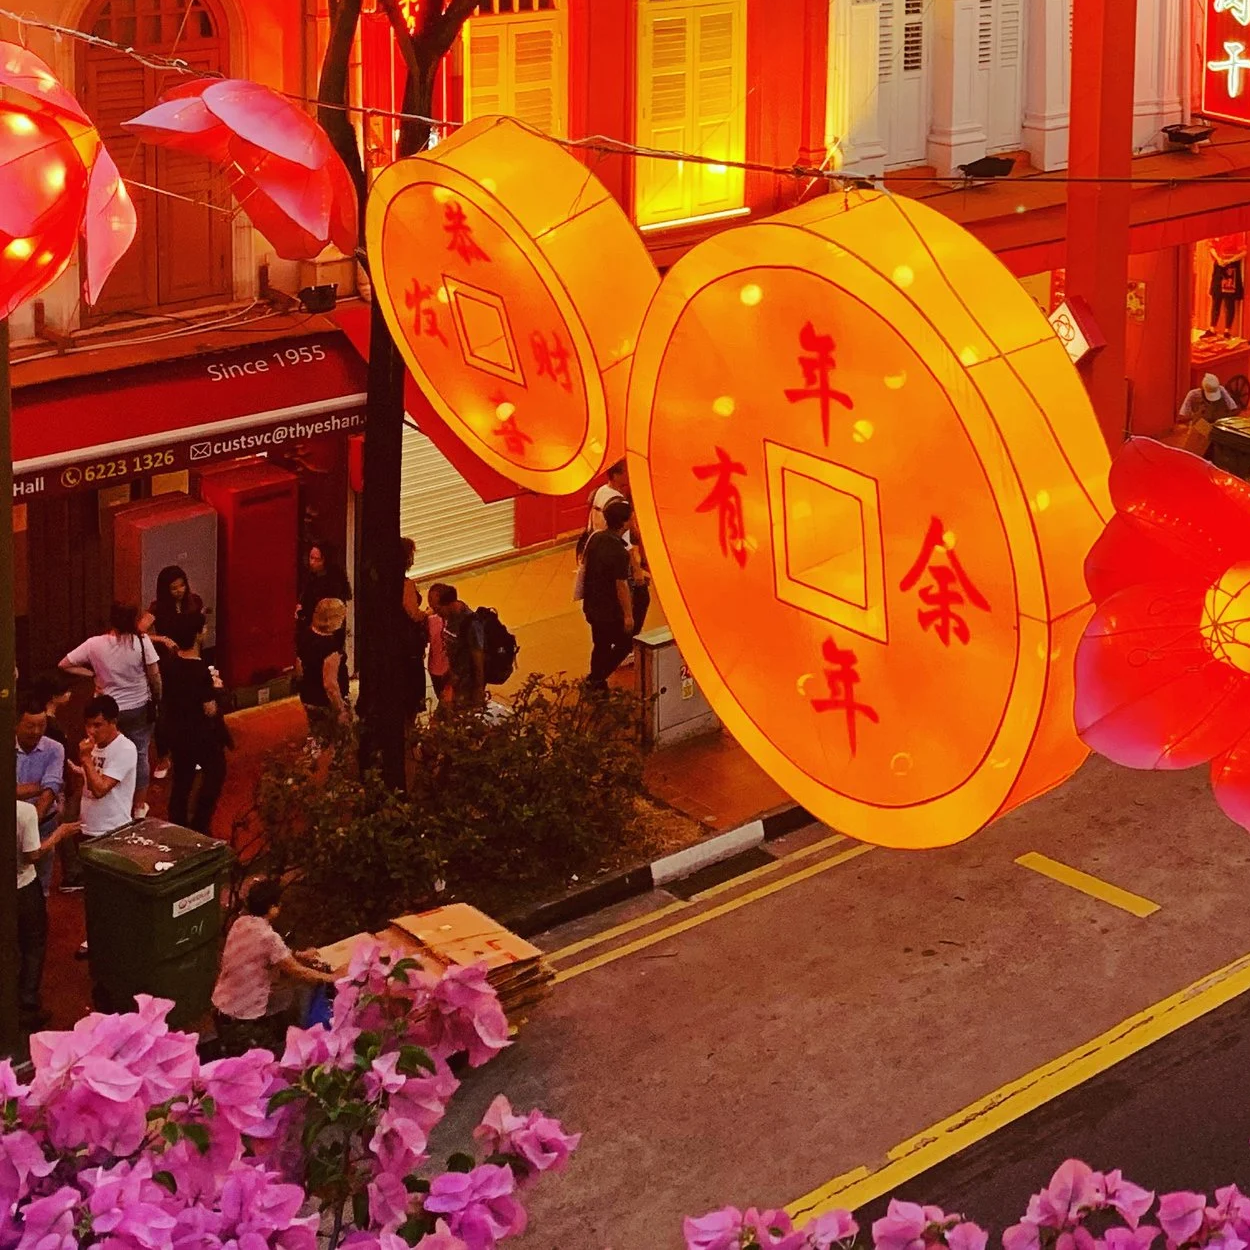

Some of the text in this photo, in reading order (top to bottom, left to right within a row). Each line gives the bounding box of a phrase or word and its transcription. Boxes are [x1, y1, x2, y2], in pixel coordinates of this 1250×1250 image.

[206, 344, 327, 383] Since 1955
[12, 412, 368, 498] Hall 6223 1326 custsvc@thyeshan.
[691, 320, 993, 758] 年 年 有 余
